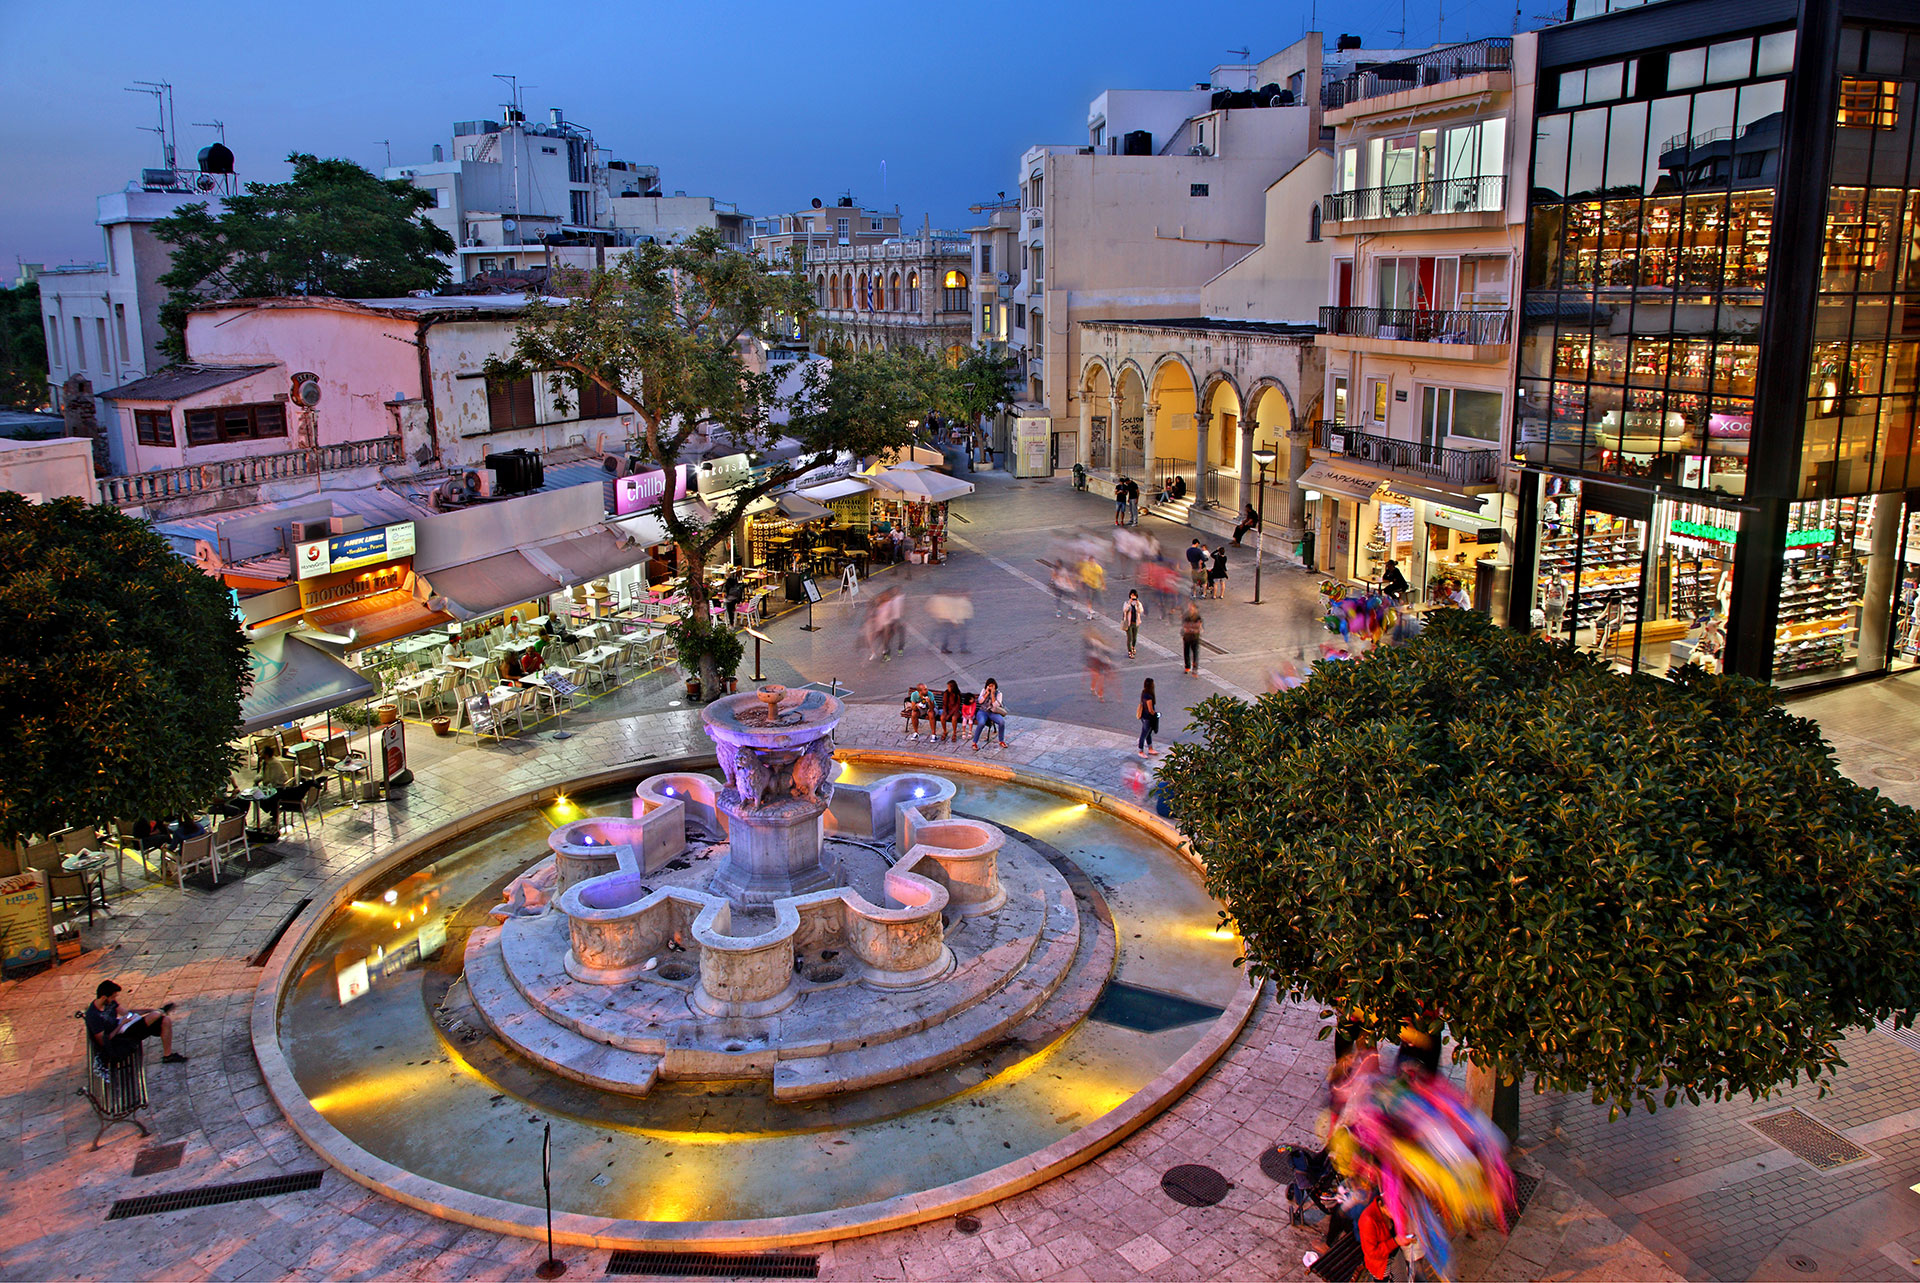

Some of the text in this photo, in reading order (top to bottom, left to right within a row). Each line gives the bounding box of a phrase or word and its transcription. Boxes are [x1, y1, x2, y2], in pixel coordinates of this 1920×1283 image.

[1671, 519, 1738, 544] COSMOS
[305, 578, 371, 605] morosini
[313, 590, 408, 623] morosini travel
